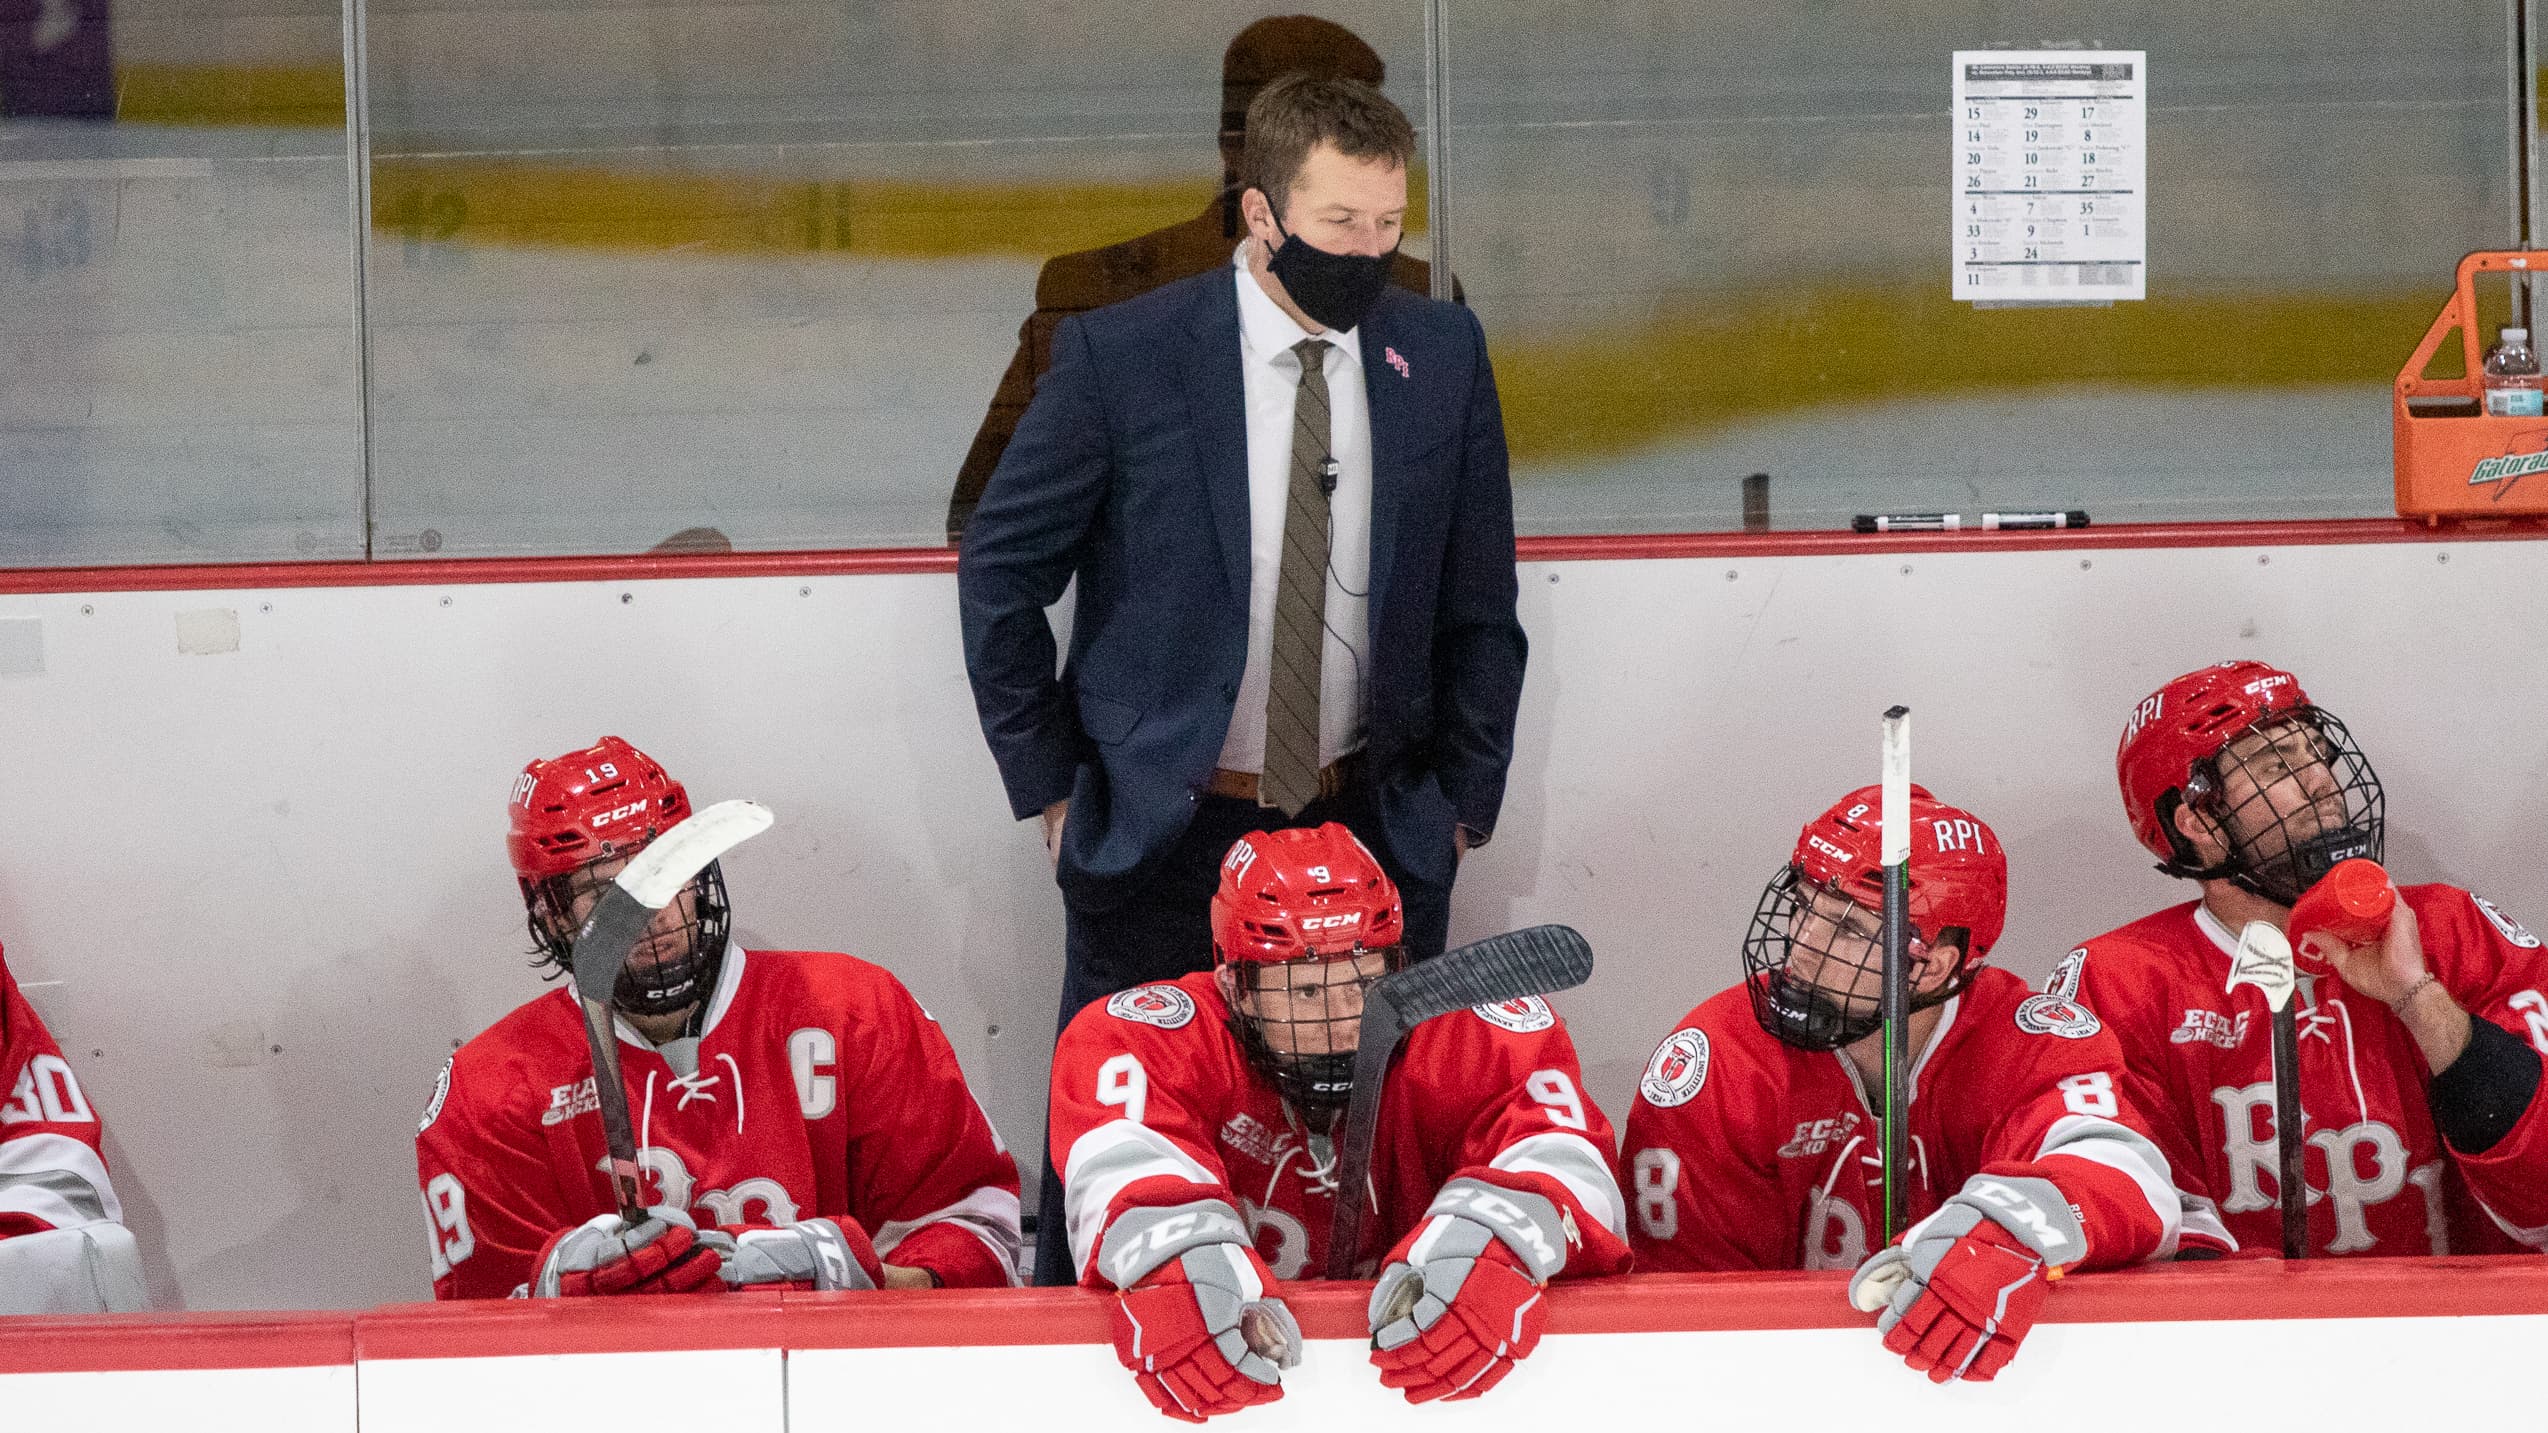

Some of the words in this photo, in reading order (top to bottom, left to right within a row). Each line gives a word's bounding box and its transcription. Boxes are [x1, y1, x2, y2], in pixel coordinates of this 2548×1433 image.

[1968, 108, 1980, 119] 15
[2025, 108, 2038, 119] 29
[2083, 107, 2094, 119] 17
[1968, 130, 1980, 142] 14
[2026, 130, 2038, 142] 19
[2083, 130, 2092, 141] 8
[1968, 153, 1980, 164] 20
[2026, 153, 2038, 164] 10
[2083, 153, 2095, 164] 18
[1967, 175, 1981, 187] 26
[2025, 176, 2036, 187] 21
[2082, 175, 2094, 187] 27
[1969, 204, 1977, 214] 4
[2027, 203, 2035, 213] 7
[2080, 202, 2093, 214] 35
[1967, 225, 1980, 237] 33
[2027, 225, 2035, 237] 9
[2084, 224, 2089, 236] 1
[1969, 248, 1978, 260] 3
[2025, 247, 2037, 259] 24
[1968, 274, 1979, 285] 11
[1385, 346, 1410, 378] RPI
[2243, 675, 2287, 695] CCM
[2126, 692, 2165, 745] RPI
[585, 762, 619, 784] 19
[591, 798, 648, 827] CCM
[1847, 804, 1869, 818] 8
[1932, 819, 1985, 856] RPI
[1808, 834, 1854, 863] CCM
[1224, 839, 1257, 889] RPI
[1313, 865, 1331, 884] 9
[1302, 912, 1361, 931] CCM
[787, 1027, 836, 1120] C
[1096, 1053, 1147, 1123] 9
[1312, 1081, 1353, 1092] CC
[1526, 1068, 1588, 1132] 9
[2056, 1071, 2119, 1119] 8
[1633, 1147, 1681, 1240] 8
[1970, 1180, 2069, 1248] CM
[2068, 1203, 2086, 1224] RPI
[421, 1173, 476, 1283] 19
